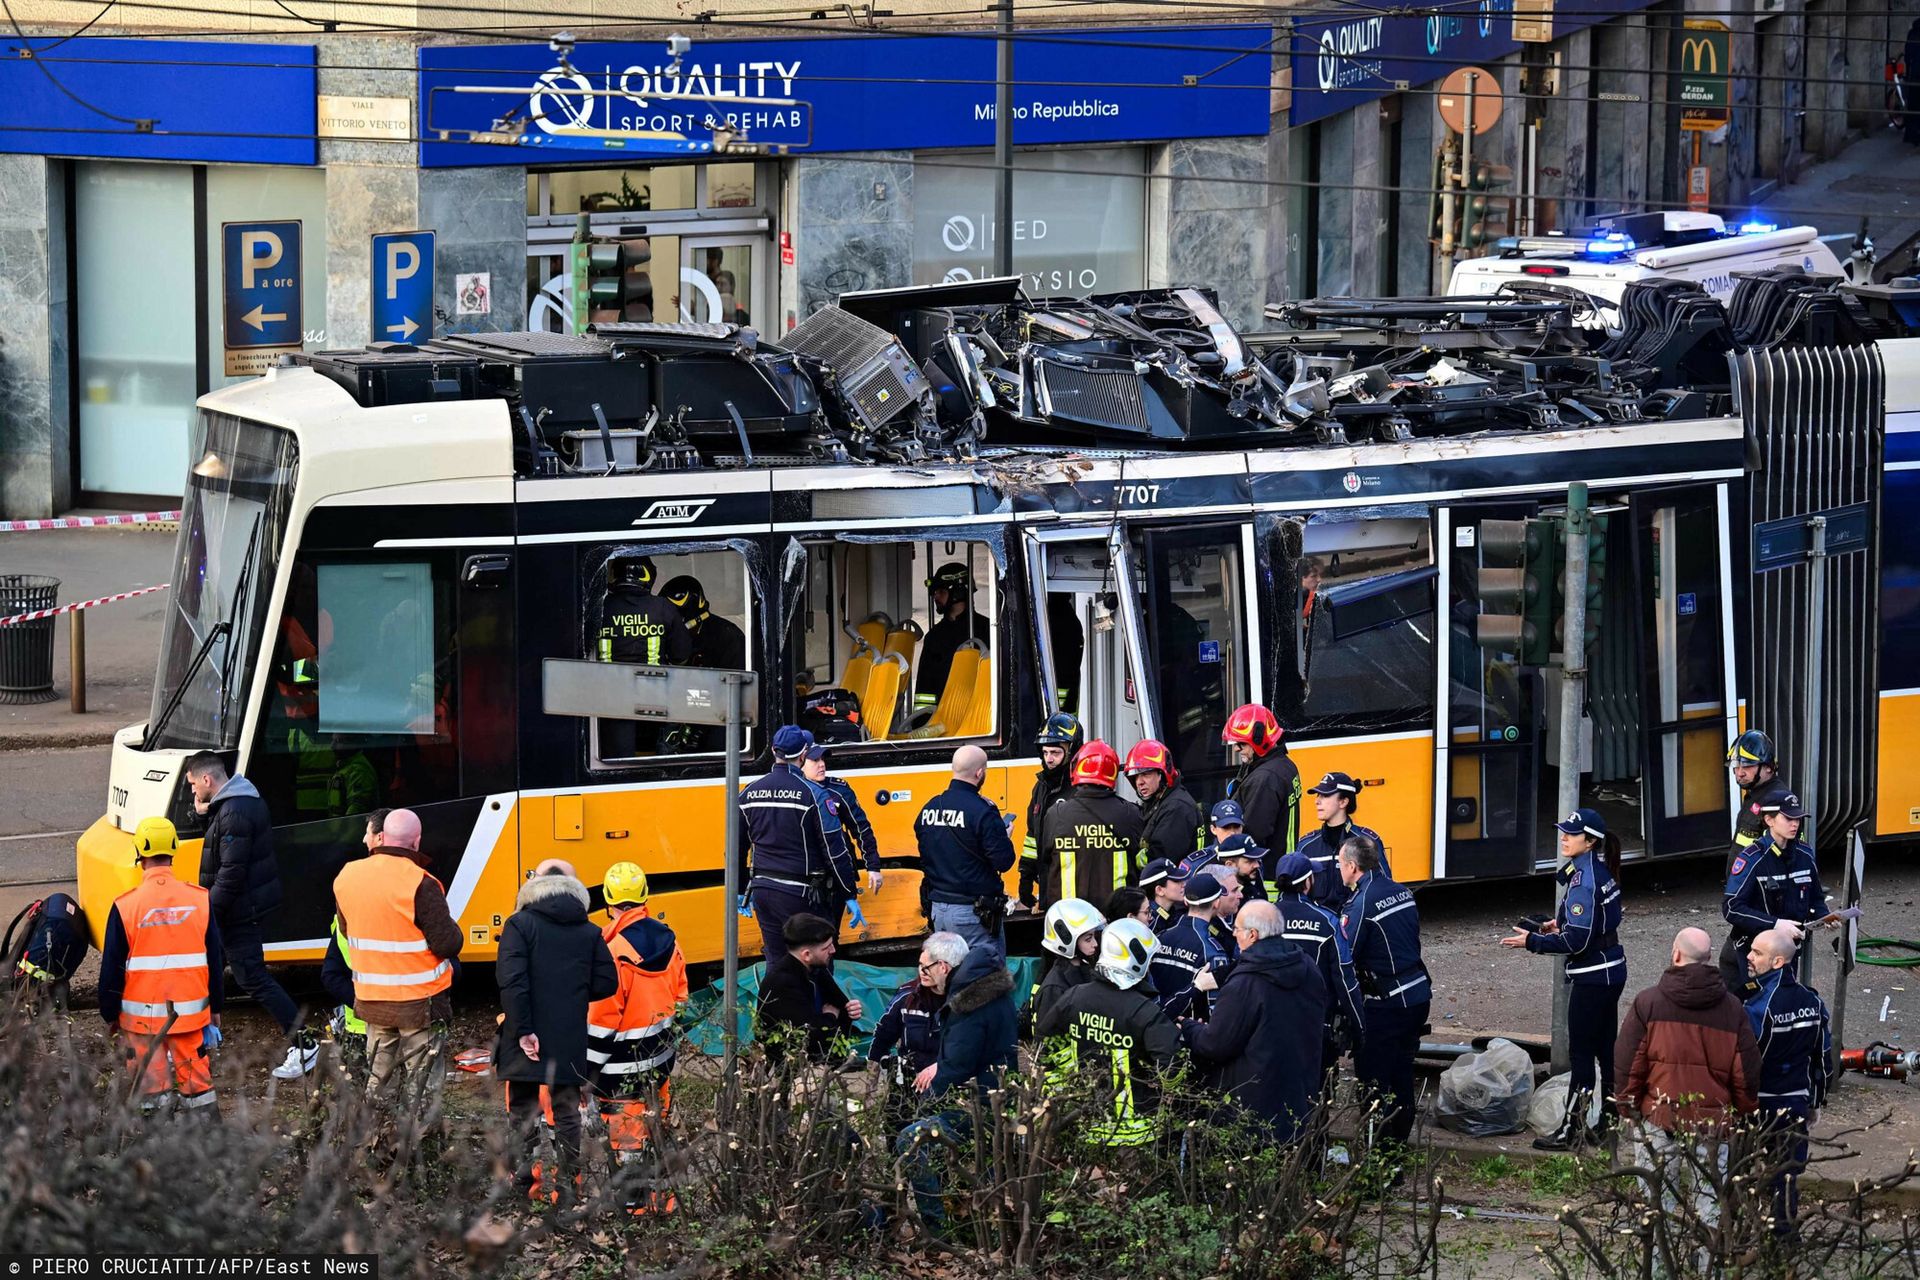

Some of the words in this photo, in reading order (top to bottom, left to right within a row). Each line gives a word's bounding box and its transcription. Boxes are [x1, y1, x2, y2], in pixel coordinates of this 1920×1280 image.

[1339, 17, 1383, 63] QUALITY
[619, 61, 801, 108] QUALITY
[352, 101, 375, 110] VIALE
[974, 102, 1028, 121] Milno
[1033, 99, 1119, 122] Repubblica
[320, 118, 366, 128] VITTORIO
[369, 119, 407, 130] VENETO
[620, 114, 695, 132] SPORT
[704, 115, 717, 131] &
[727, 110, 802, 129] REHAB
[991, 220, 1047, 241] ED
[241, 230, 284, 289] P
[386, 241, 421, 300] P
[262, 279, 269, 288] a
[274, 277, 293, 288] ore
[1701, 272, 1740, 294] COMAN
[1113, 484, 1160, 505] 7707
[656, 505, 690, 519] ATM
[612, 613, 648, 626] VIGILI
[623, 624, 665, 638] FUOCO
[112, 785, 129, 809] 7707
[747, 789, 772, 800] POLIZIA
[774, 789, 803, 800] LOCALE
[921, 809, 966, 829] POLIZIA
[1055, 837, 1081, 849] DEL
[1375, 895, 1398, 911] POLIZIA
[493, 914, 502, 927] B
[1286, 919, 1321, 931] LOCALE
[1174, 947, 1199, 963] LOCALE
[1079, 1011, 1115, 1032] VIGILI
[1069, 1023, 1082, 1039] EL
[1086, 1027, 1134, 1049] FUOCO
